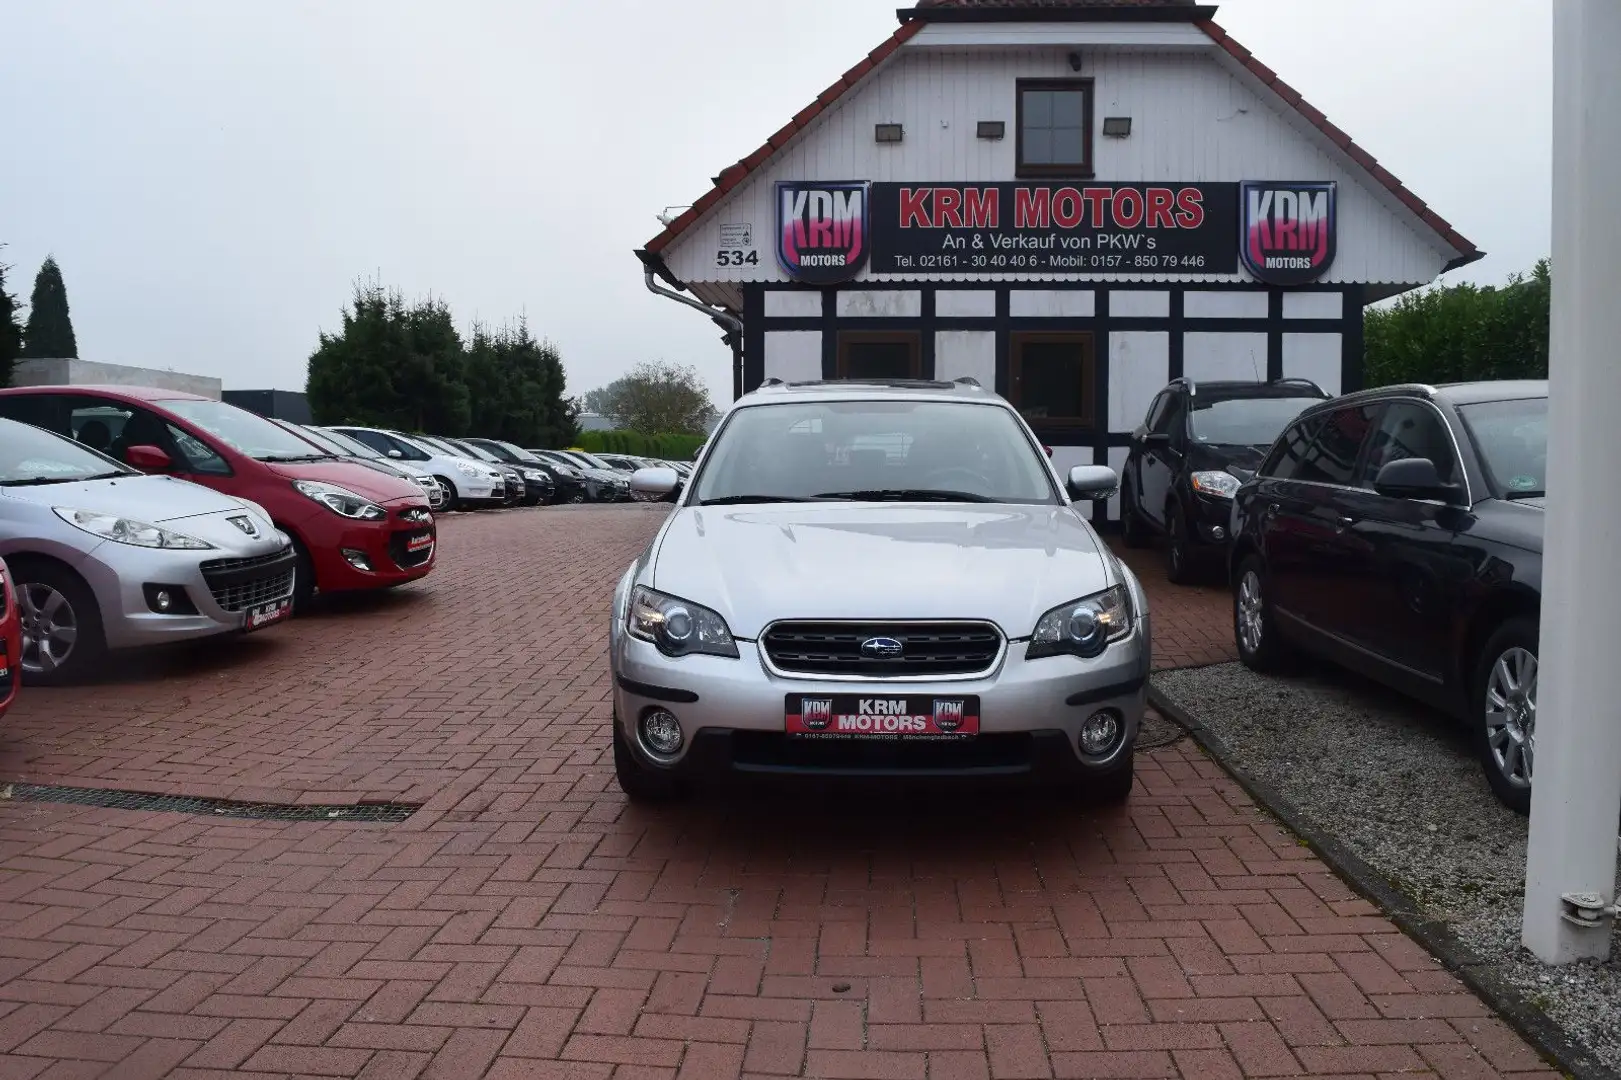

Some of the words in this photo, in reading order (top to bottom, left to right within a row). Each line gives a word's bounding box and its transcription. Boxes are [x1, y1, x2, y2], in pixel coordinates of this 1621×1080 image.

[899, 187, 1000, 228] KRM
[1014, 187, 1205, 229] MOTORS
[783, 190, 862, 248] KRM
[1250, 190, 1328, 249] KRM
[942, 234, 965, 249] An
[971, 234, 985, 249] &
[991, 233, 1055, 249] Verkauf
[1060, 237, 1091, 249] von
[717, 250, 759, 266] 534
[800, 254, 846, 267] MOTORS
[894, 255, 916, 267] Tel.
[919, 255, 958, 267] 02161
[971, 255, 987, 267] 30
[990, 255, 1007, 267] 40
[1009, 255, 1027, 267] 40
[1029, 255, 1037, 267] 6
[1050, 254, 1087, 267] Mobil:
[1090, 255, 1121, 267] 0157
[1134, 255, 1158, 267] 850
[1161, 255, 1178, 267] 79
[1181, 255, 1205, 267] 446
[1265, 257, 1311, 269] MOTORS
[859, 699, 907, 714] KRM
[838, 715, 926, 730] MOTORS
